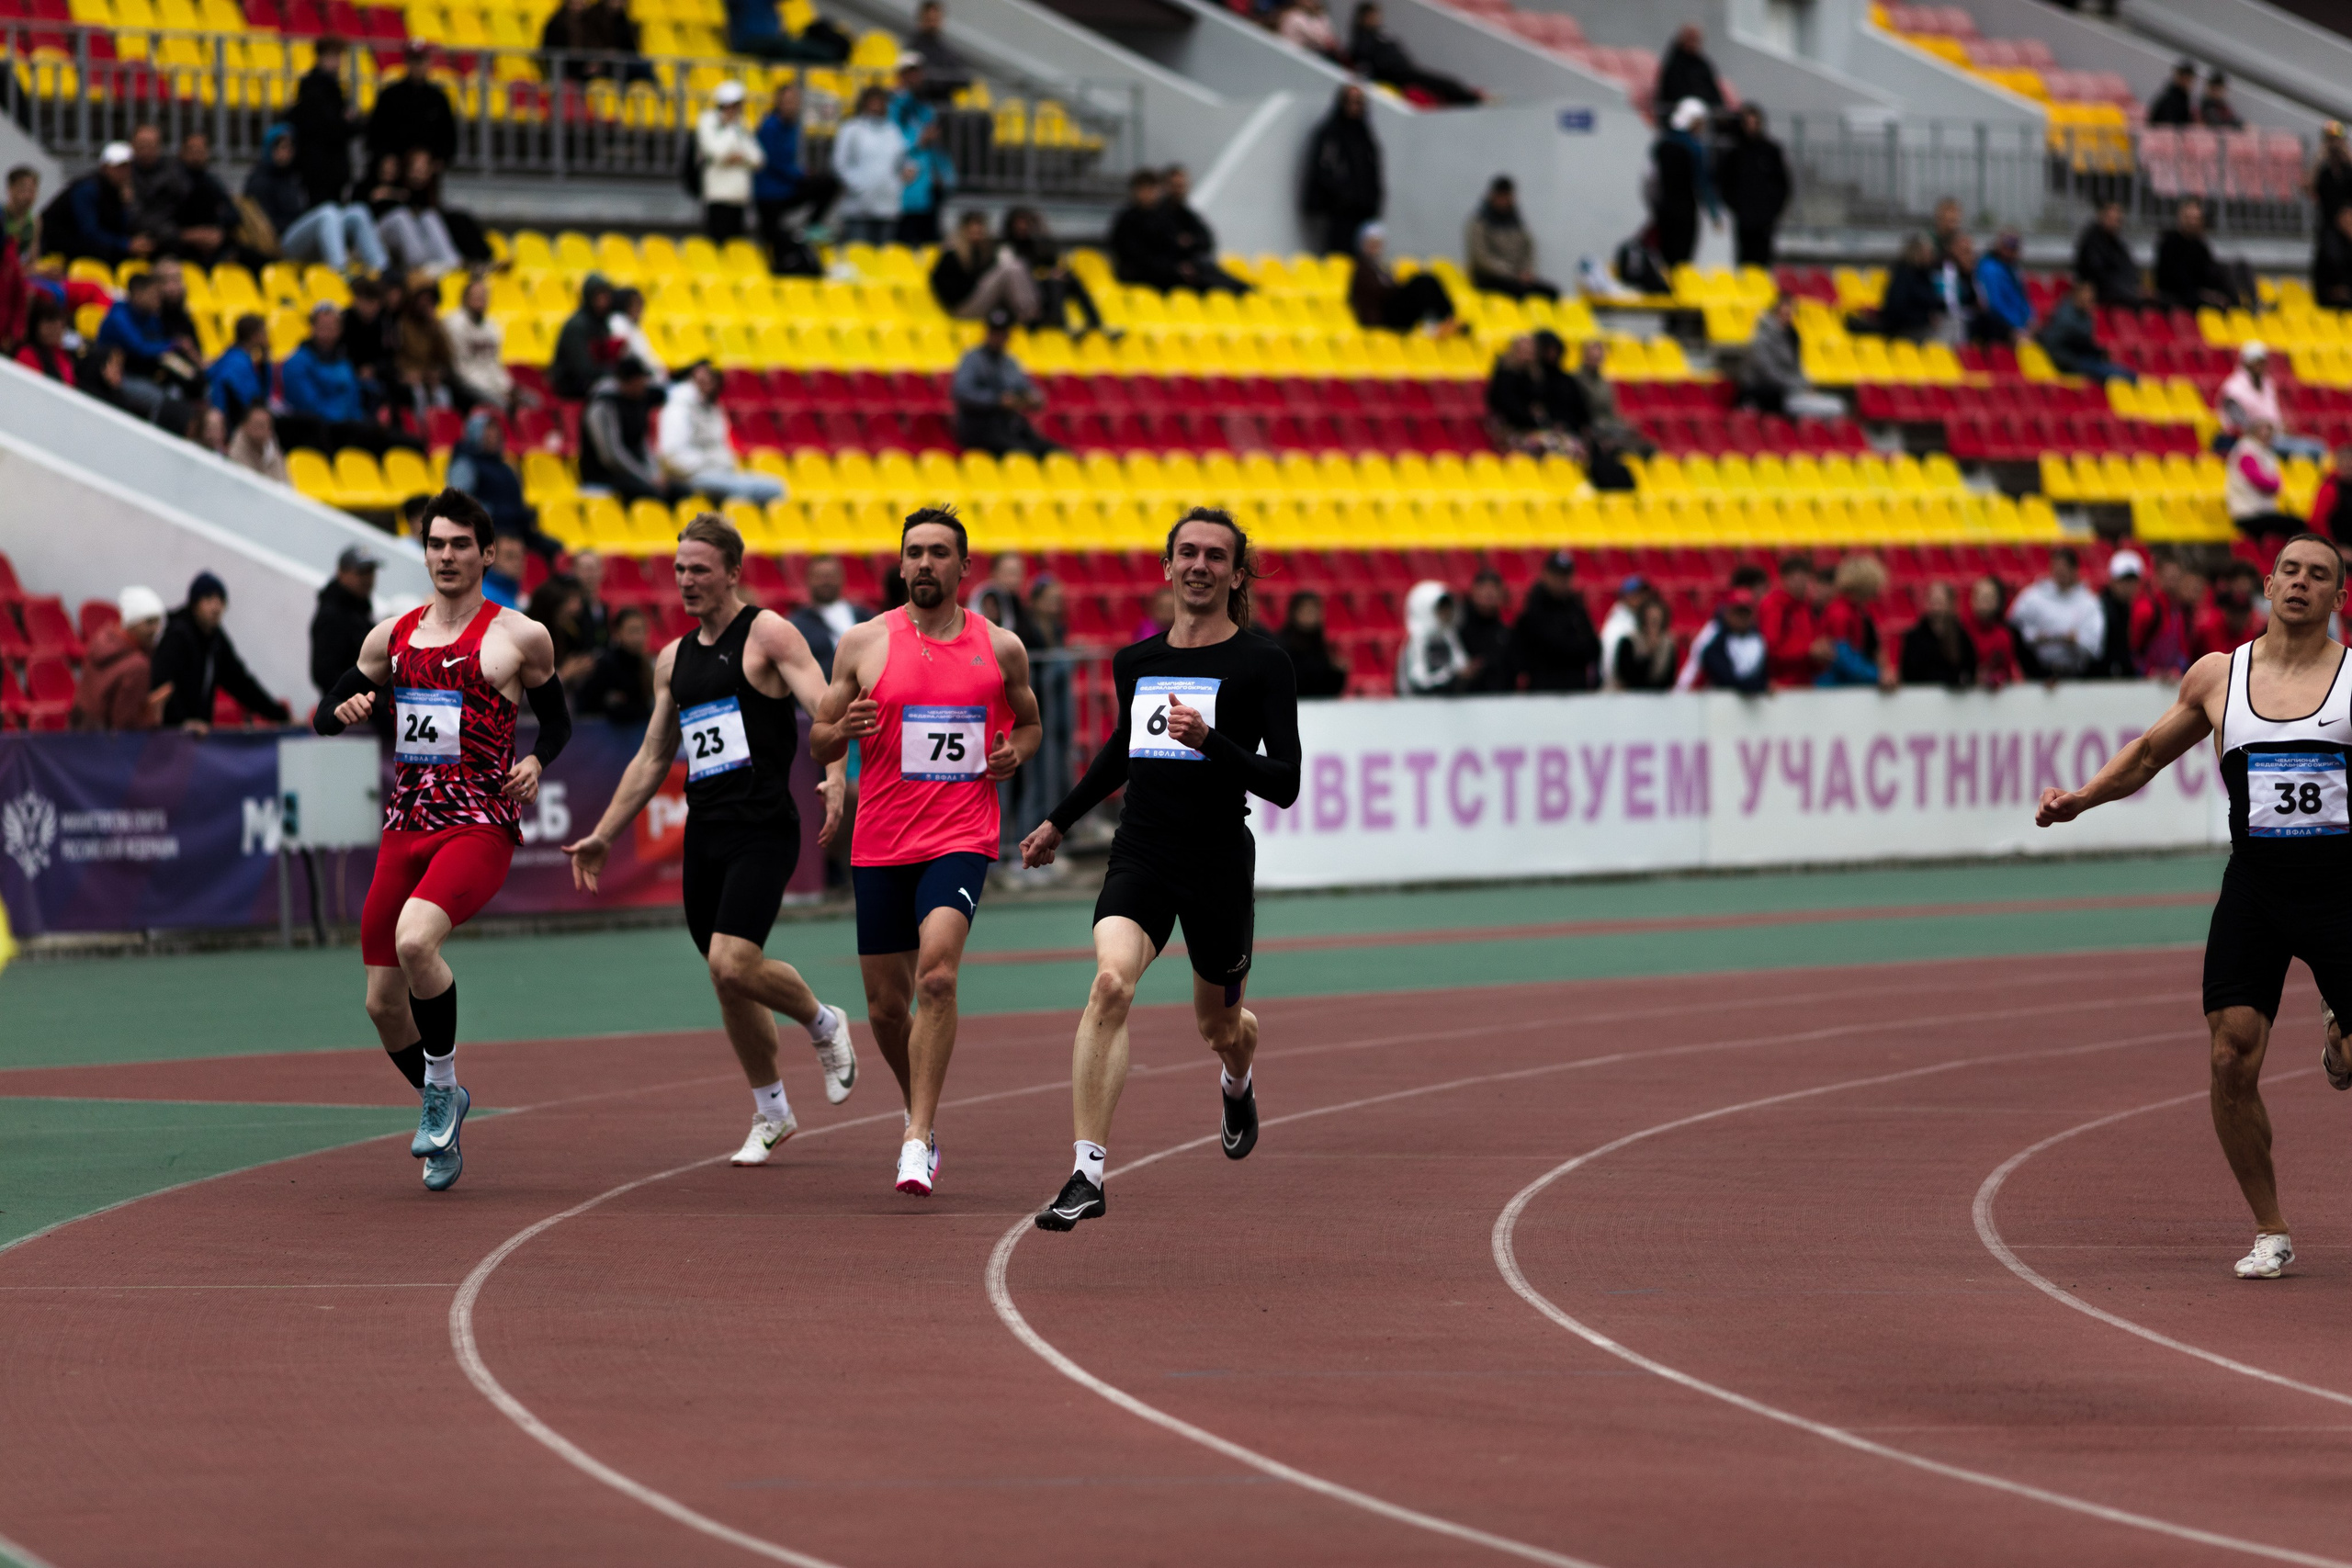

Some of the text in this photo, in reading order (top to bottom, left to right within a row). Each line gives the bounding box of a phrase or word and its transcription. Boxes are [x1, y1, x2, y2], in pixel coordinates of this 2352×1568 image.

[404, 713, 438, 743] 24
[1147, 705, 1168, 736] 6
[692, 726, 725, 760] 23
[927, 732, 966, 762] 75
[2273, 782, 2323, 815] 38
